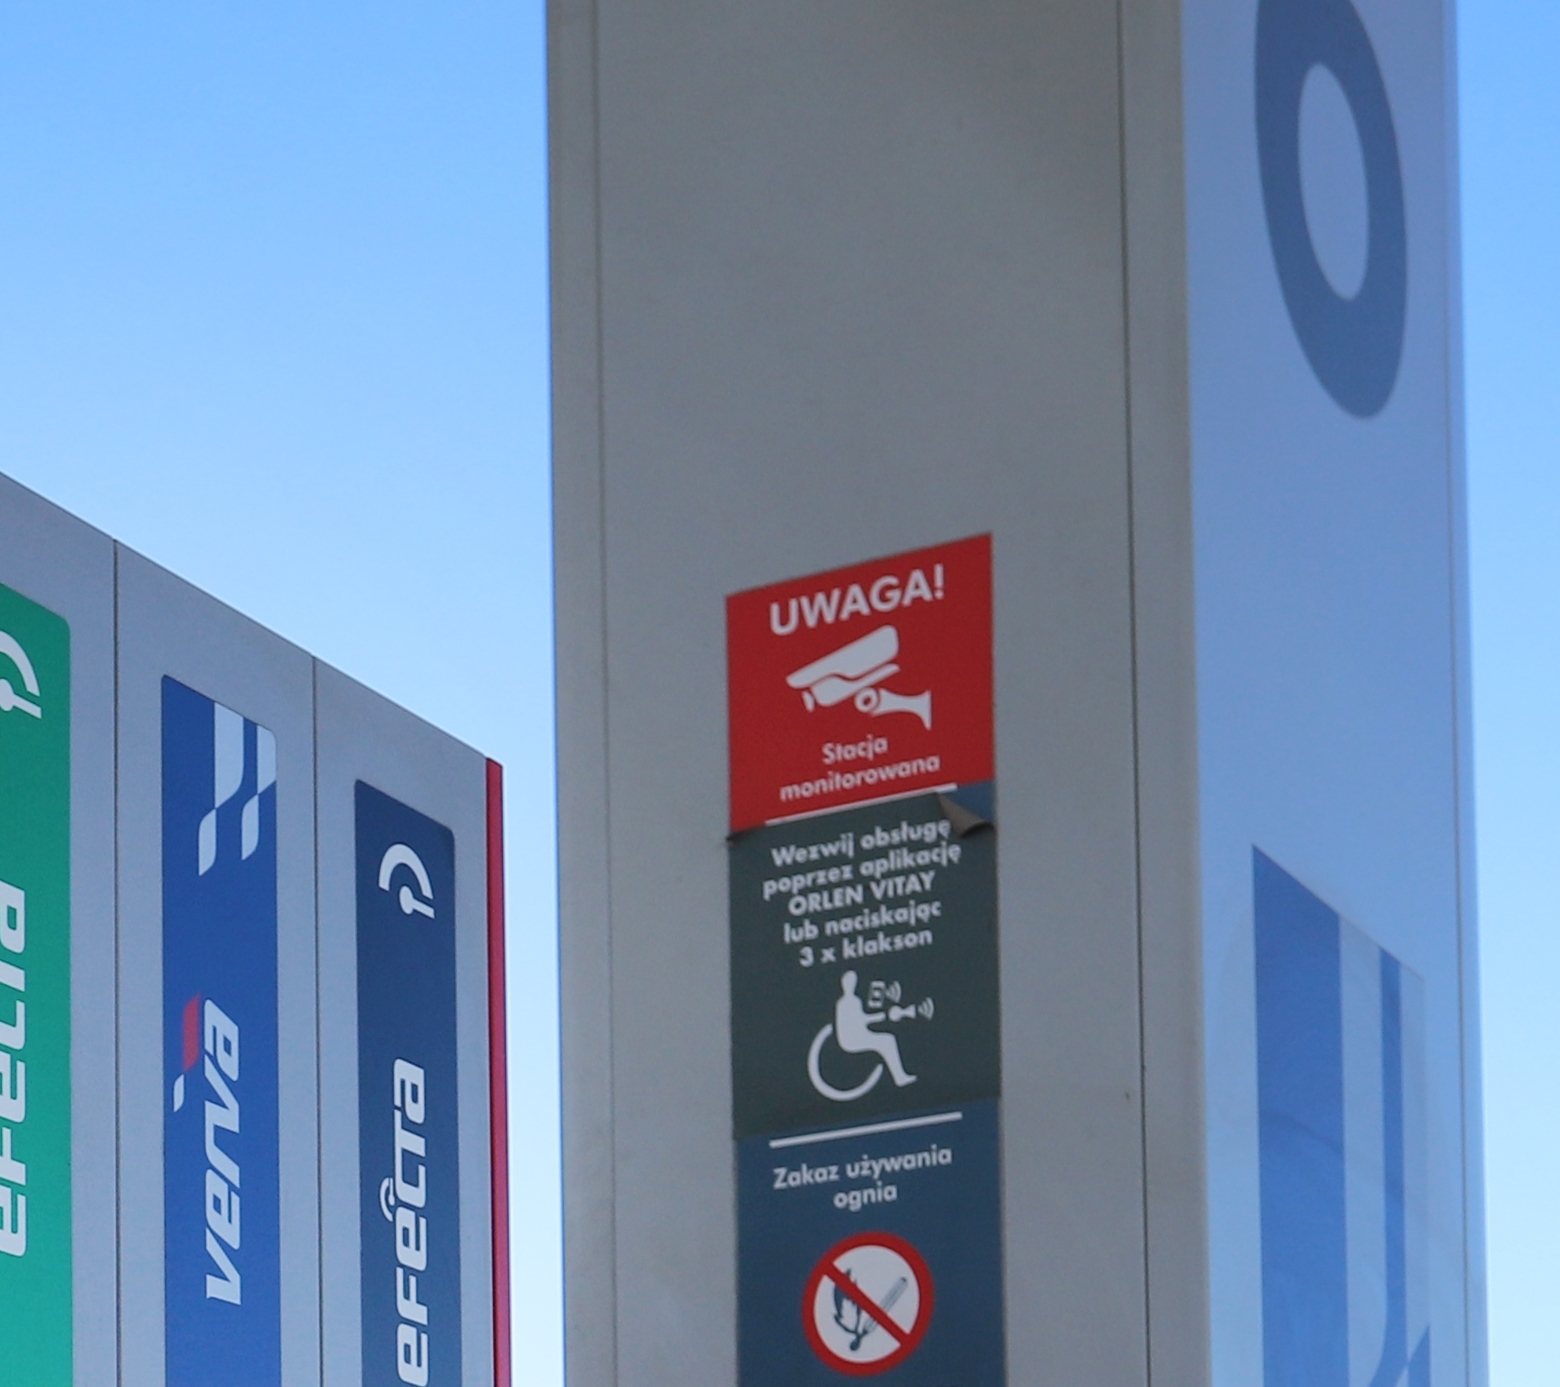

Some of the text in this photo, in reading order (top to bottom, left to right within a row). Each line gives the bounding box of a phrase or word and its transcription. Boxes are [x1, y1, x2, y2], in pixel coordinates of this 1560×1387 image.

[769, 563, 945, 636] UWAGA!
[821, 734, 889, 765] Stacja
[779, 755, 941, 802] monitorowana
[771, 818, 952, 868] Wezwij obsługę
[763, 841, 962, 901] poprzez aplikację
[788, 871, 936, 916] ORLEN VITAY
[784, 899, 942, 944] lub naciskając
[799, 927, 933, 968] 3 x klakson
[203, 998, 242, 1306] verva
[773, 1145, 952, 1190] Zakaz używania
[833, 1182, 898, 1212] ognia
[392, 1057, 430, 1387] efecta
